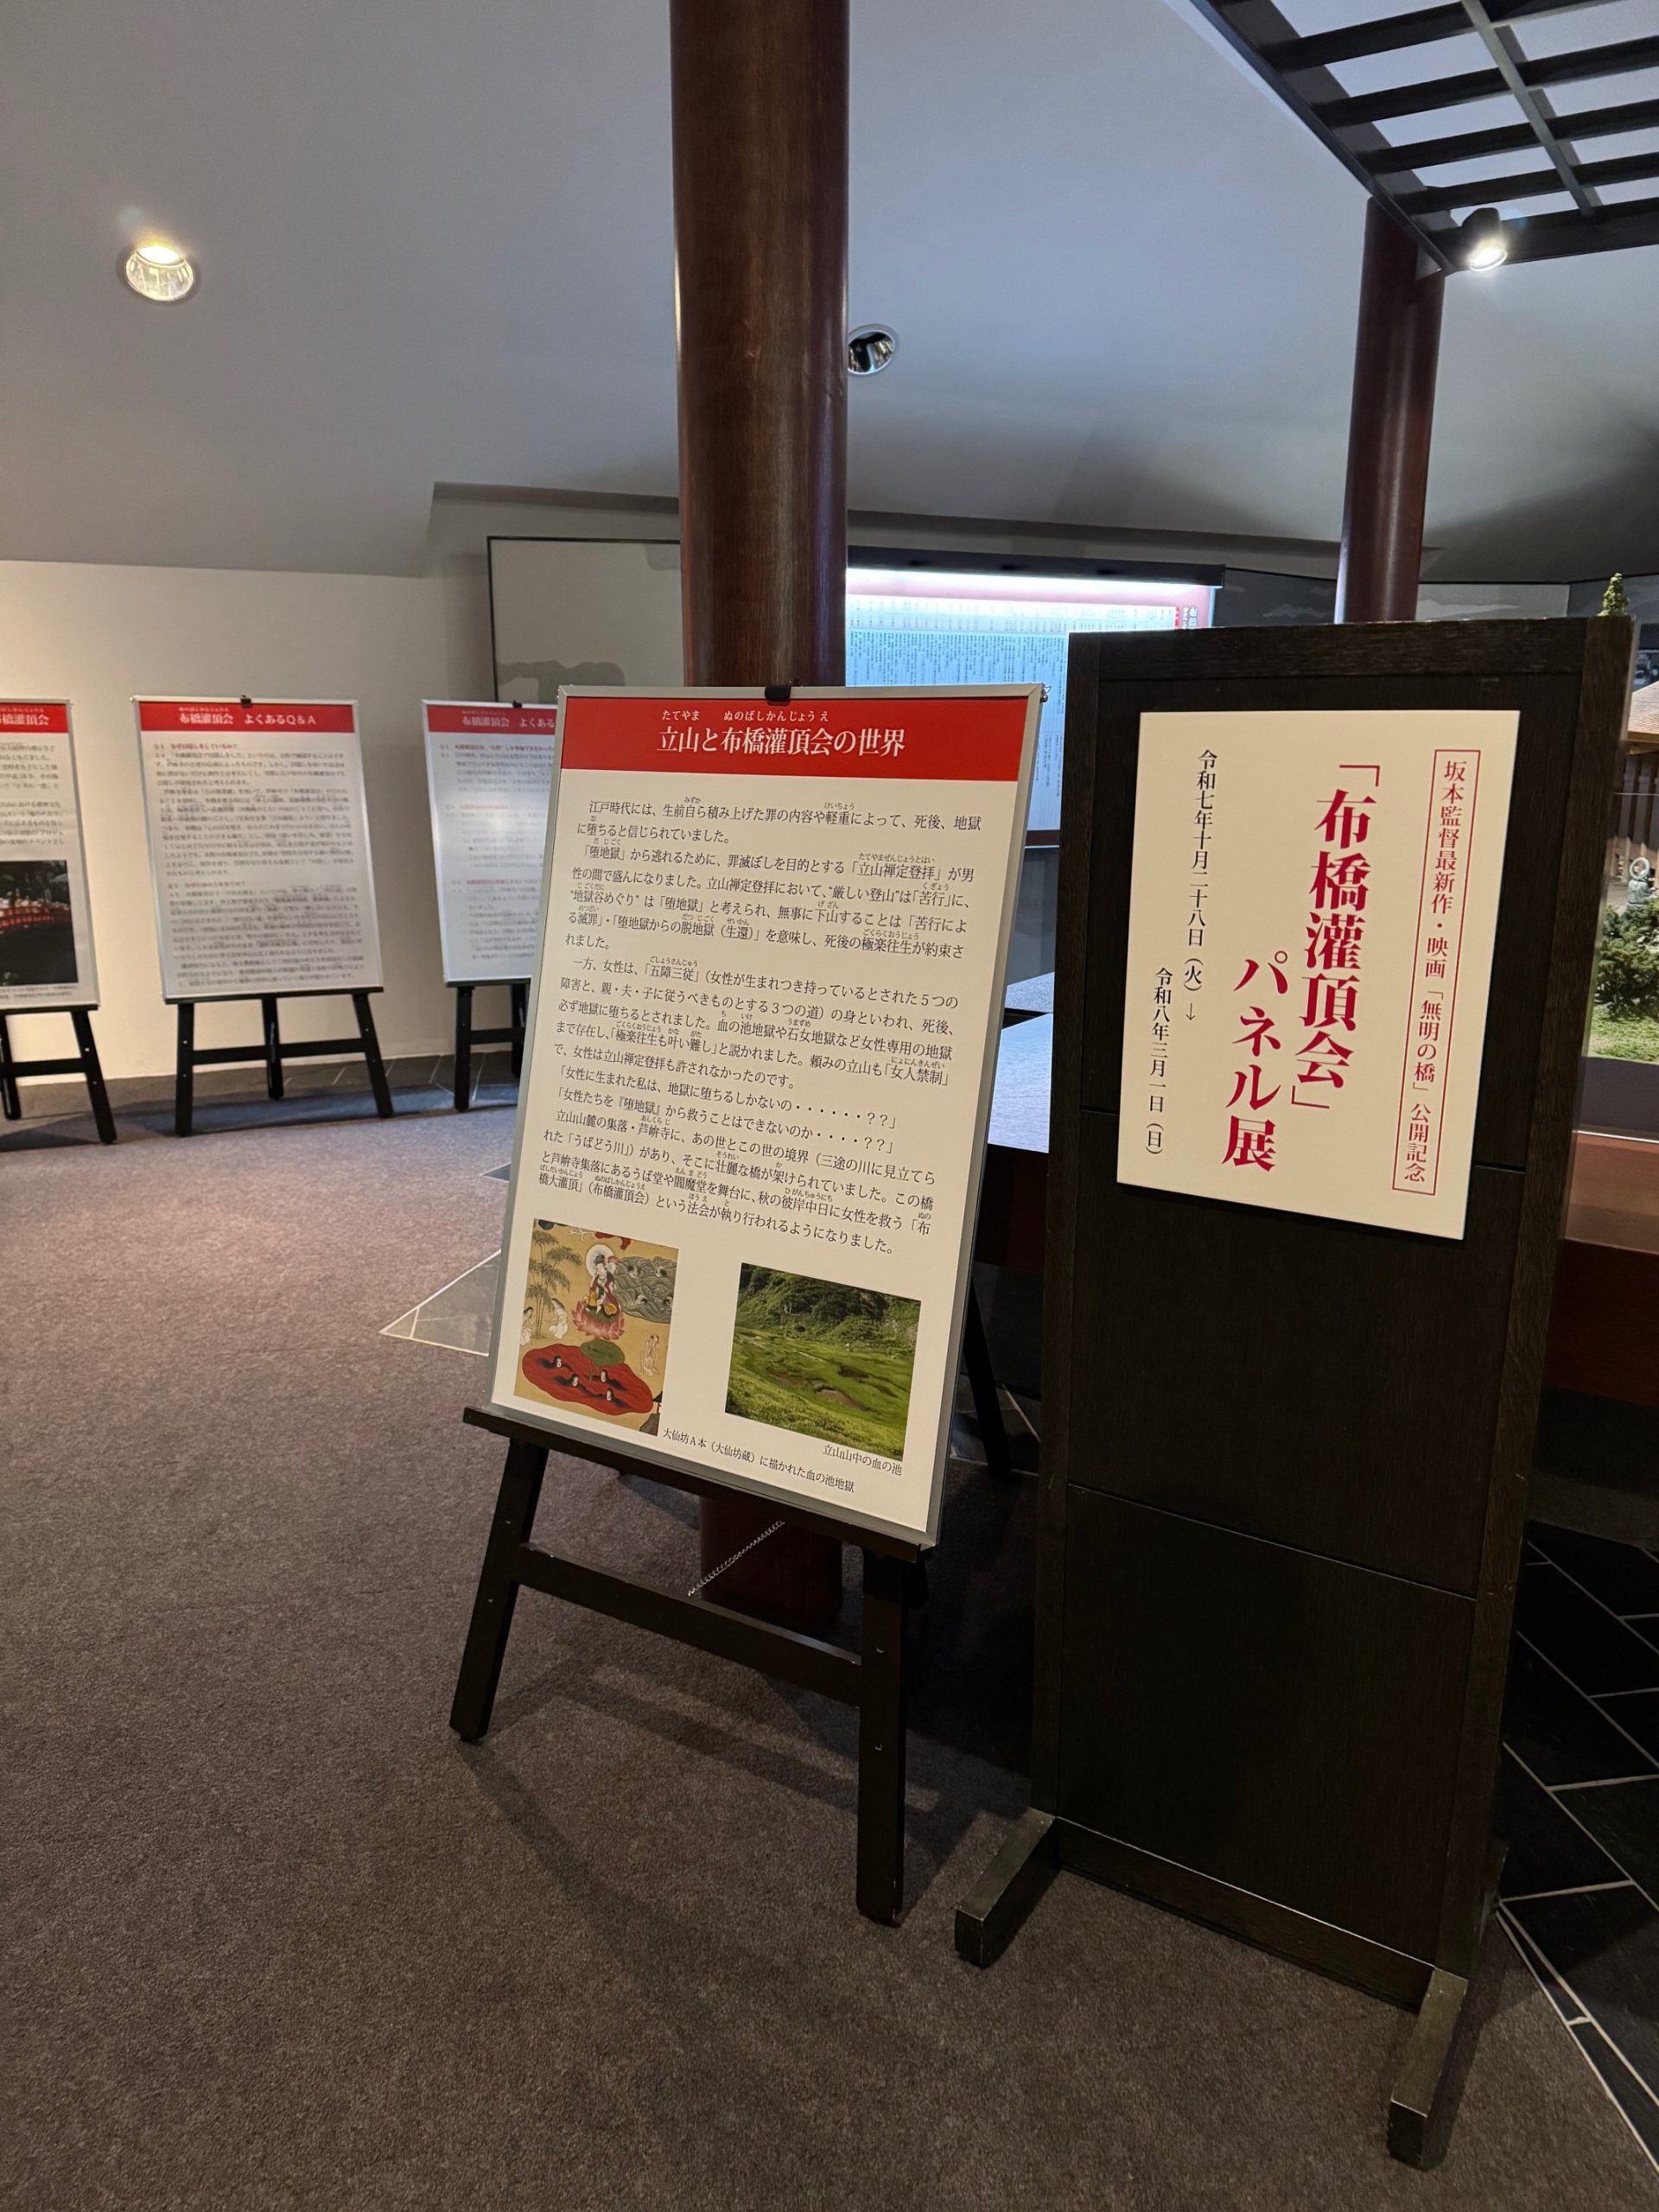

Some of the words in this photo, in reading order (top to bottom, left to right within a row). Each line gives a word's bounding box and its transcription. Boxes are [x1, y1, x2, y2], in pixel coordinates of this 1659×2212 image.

[662, 709, 701, 721] たてやま
[657, 726, 906, 758] 立山と布橋灌頂会の世界
[566, 933, 609, 950] れました。
[1291, 764, 1381, 1109] 「布橋灌頂会」
[1221, 950, 1289, 1173] パネル展
